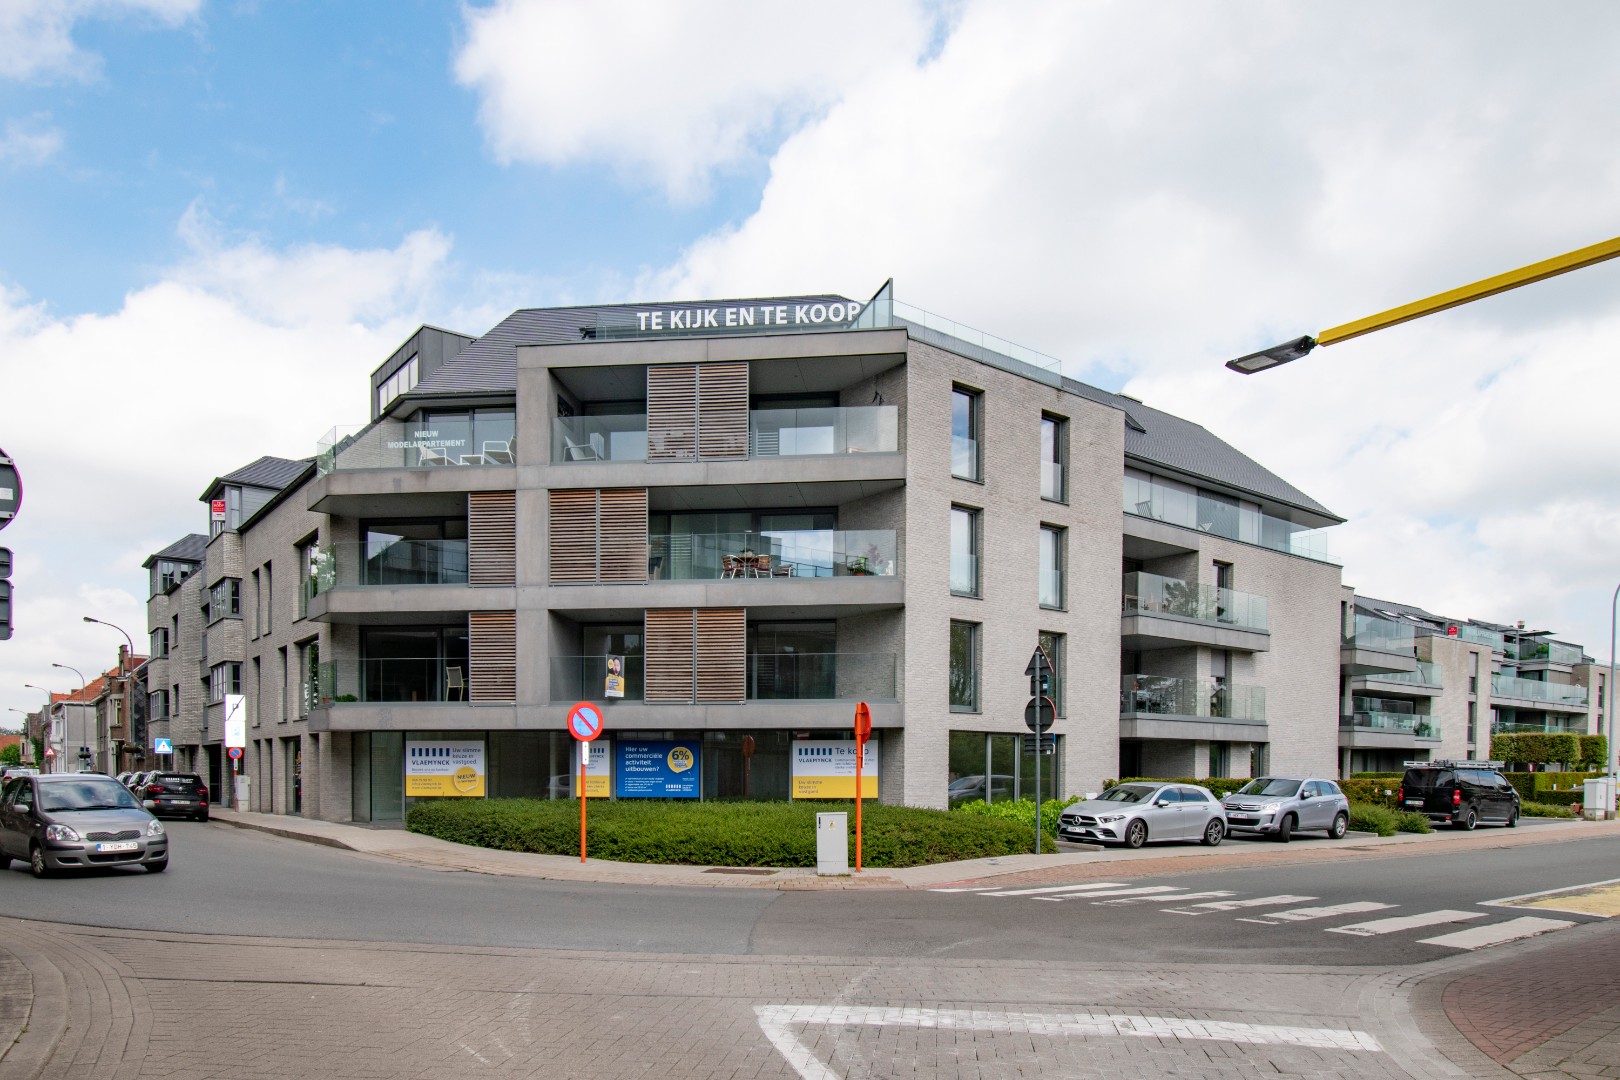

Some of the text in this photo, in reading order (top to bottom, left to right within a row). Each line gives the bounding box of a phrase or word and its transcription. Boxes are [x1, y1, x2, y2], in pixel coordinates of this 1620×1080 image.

[637, 303, 861, 331] TE KIJK EN TE KOOP
[387, 440, 466, 449] MODELAPPARTEMENT
[672, 750, 690, 761] 6%
[835, 747, 845, 755] Te
